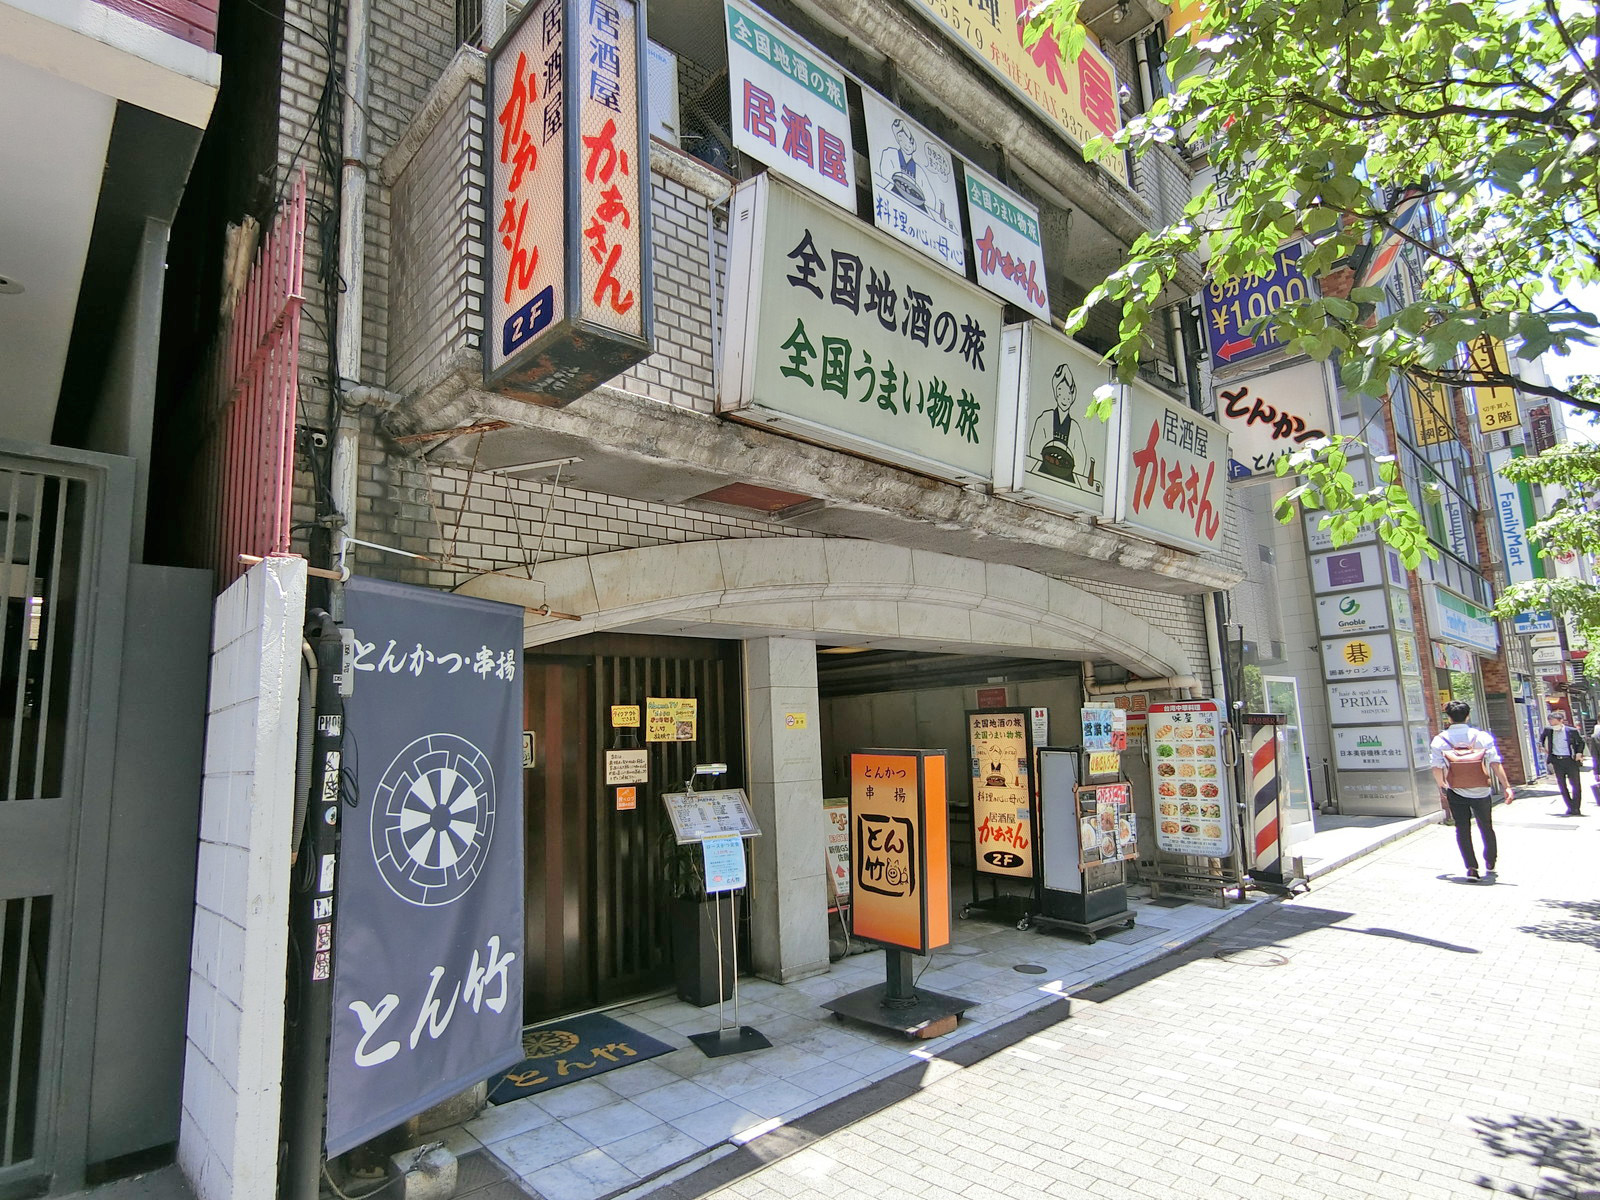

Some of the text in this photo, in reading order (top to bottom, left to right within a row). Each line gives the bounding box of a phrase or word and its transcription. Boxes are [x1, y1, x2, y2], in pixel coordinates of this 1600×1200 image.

[542, 0, 562, 147] 居酒屋
[589, 0, 622, 114] 居酒屋
[734, 16, 845, 109] 全国地酒の旅
[743, 78, 849, 188] 居酒屋
[875, 196, 964, 267] 料理の心は母心
[970, 181, 1040, 243] 全国うまい物旅
[976, 224, 1046, 309] かあさん
[511, 299, 543, 343] 2F
[786, 228, 987, 372] 全国地酒の旅
[779, 317, 981, 445] 全国うまい物旅
[1162, 407, 1208, 460] 居酒屋
[1485, 411, 1512, 427] 3階
[1132, 418, 1220, 542] かあさん
[1500, 492, 1525, 567] FamilyMart
[1338, 619, 1366, 628] Gnoble
[1347, 642, 1369, 663] 碁
[973, 717, 1023, 729] 全国地酒の旅
[1172, 712, 1193, 724] 味屋
[1340, 695, 1389, 708] PRIMA
[974, 730, 1023, 740] 全国うまい物旅
[864, 765, 907, 779] とんかつ
[977, 816, 1029, 850] かあさん
[990, 811, 1016, 824] 居酒屋
[865, 855, 886, 882] 竹
[992, 853, 1014, 866] 2F
[348, 935, 516, 1067] とん竹
[505, 1042, 639, 1088] とん竹
